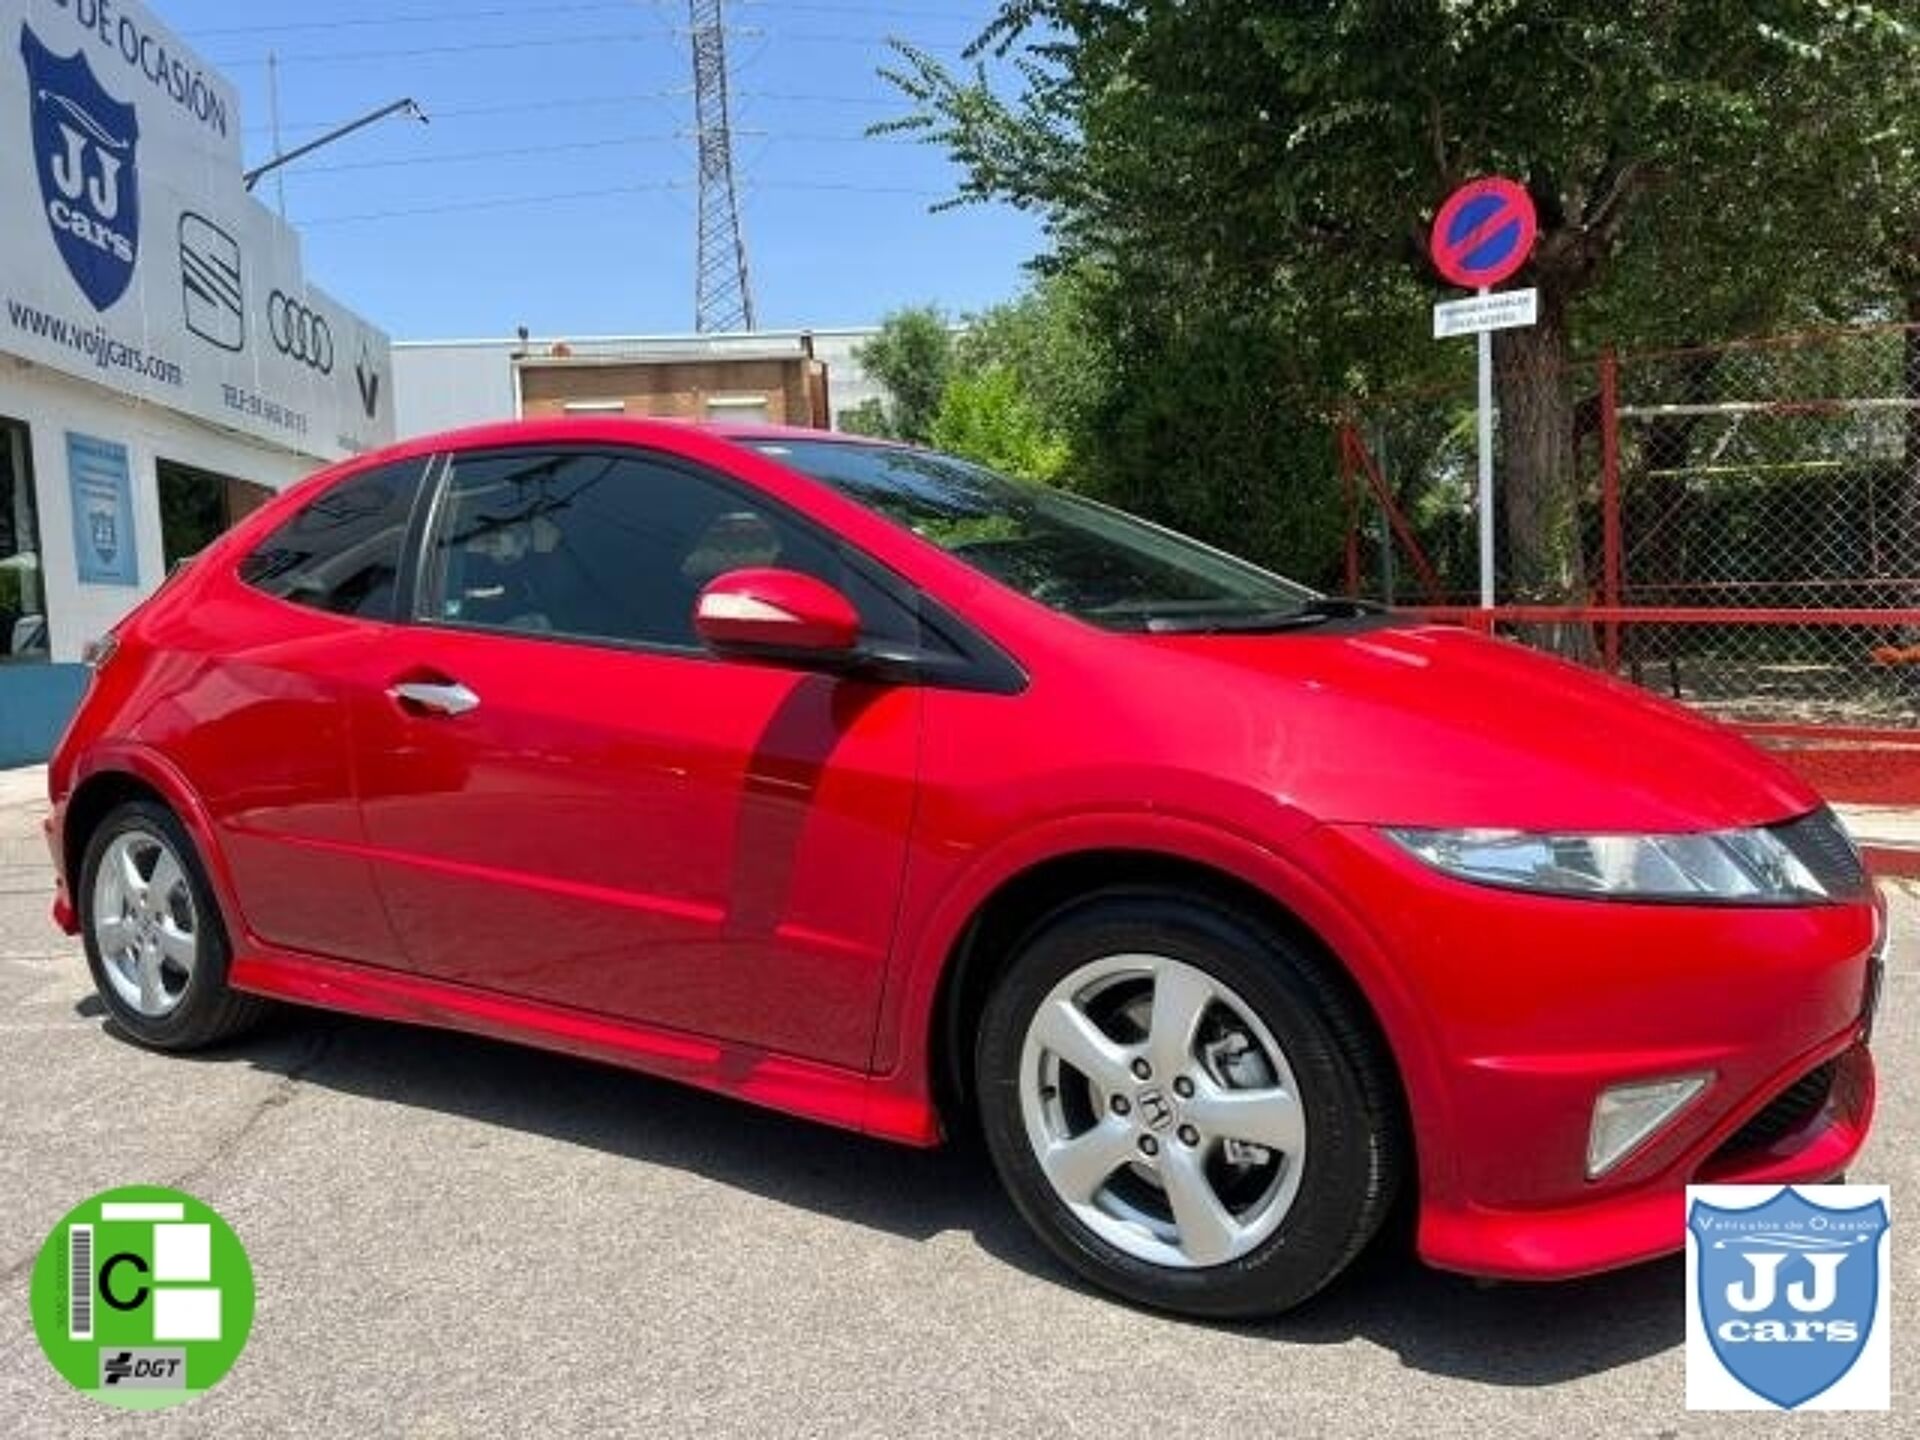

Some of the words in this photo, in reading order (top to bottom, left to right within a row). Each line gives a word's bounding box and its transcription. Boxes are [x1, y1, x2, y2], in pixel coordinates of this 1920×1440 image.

[119, 16, 227, 138] OCASIÓN
[52, 122, 122, 220] JJ
[50, 200, 134, 263] cars
